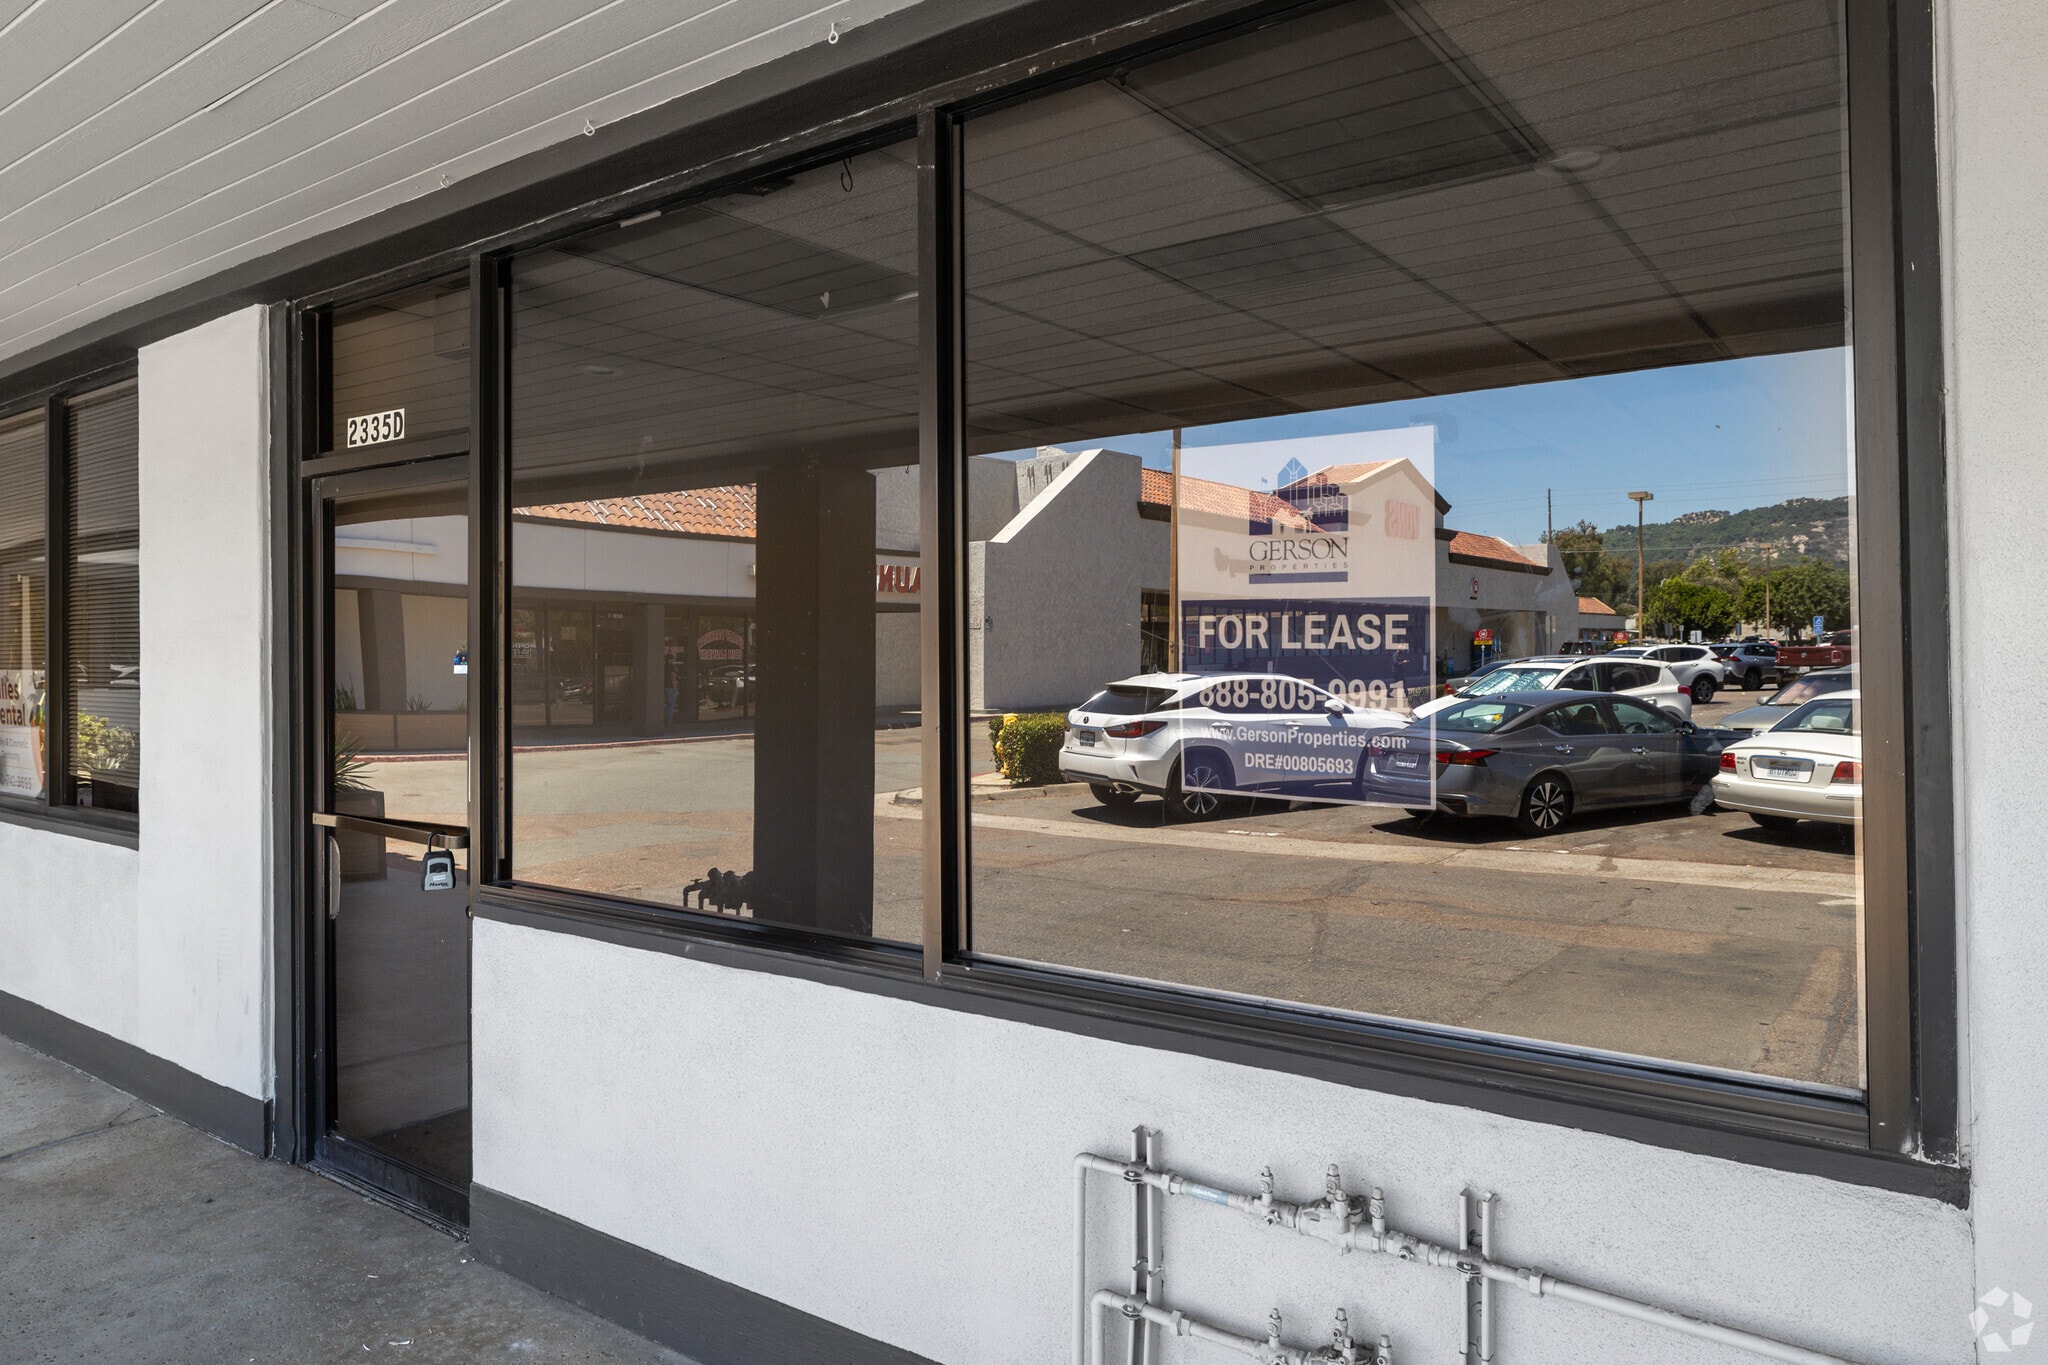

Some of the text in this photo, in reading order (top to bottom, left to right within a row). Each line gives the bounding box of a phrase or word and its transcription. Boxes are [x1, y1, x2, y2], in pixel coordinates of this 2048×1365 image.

[349, 411, 404, 445] 2335D
[1249, 537, 1349, 562] GERSON
[1249, 562, 1349, 571] PROPERTIES
[1199, 613, 1410, 651] FOR LEASE
[1199, 678, 1411, 714] 888-805-9991
[0, 703, 26, 727] ental
[1200, 726, 1408, 749] www.GersonProperties.com
[1244, 752, 1353, 774] DRE#00805693
